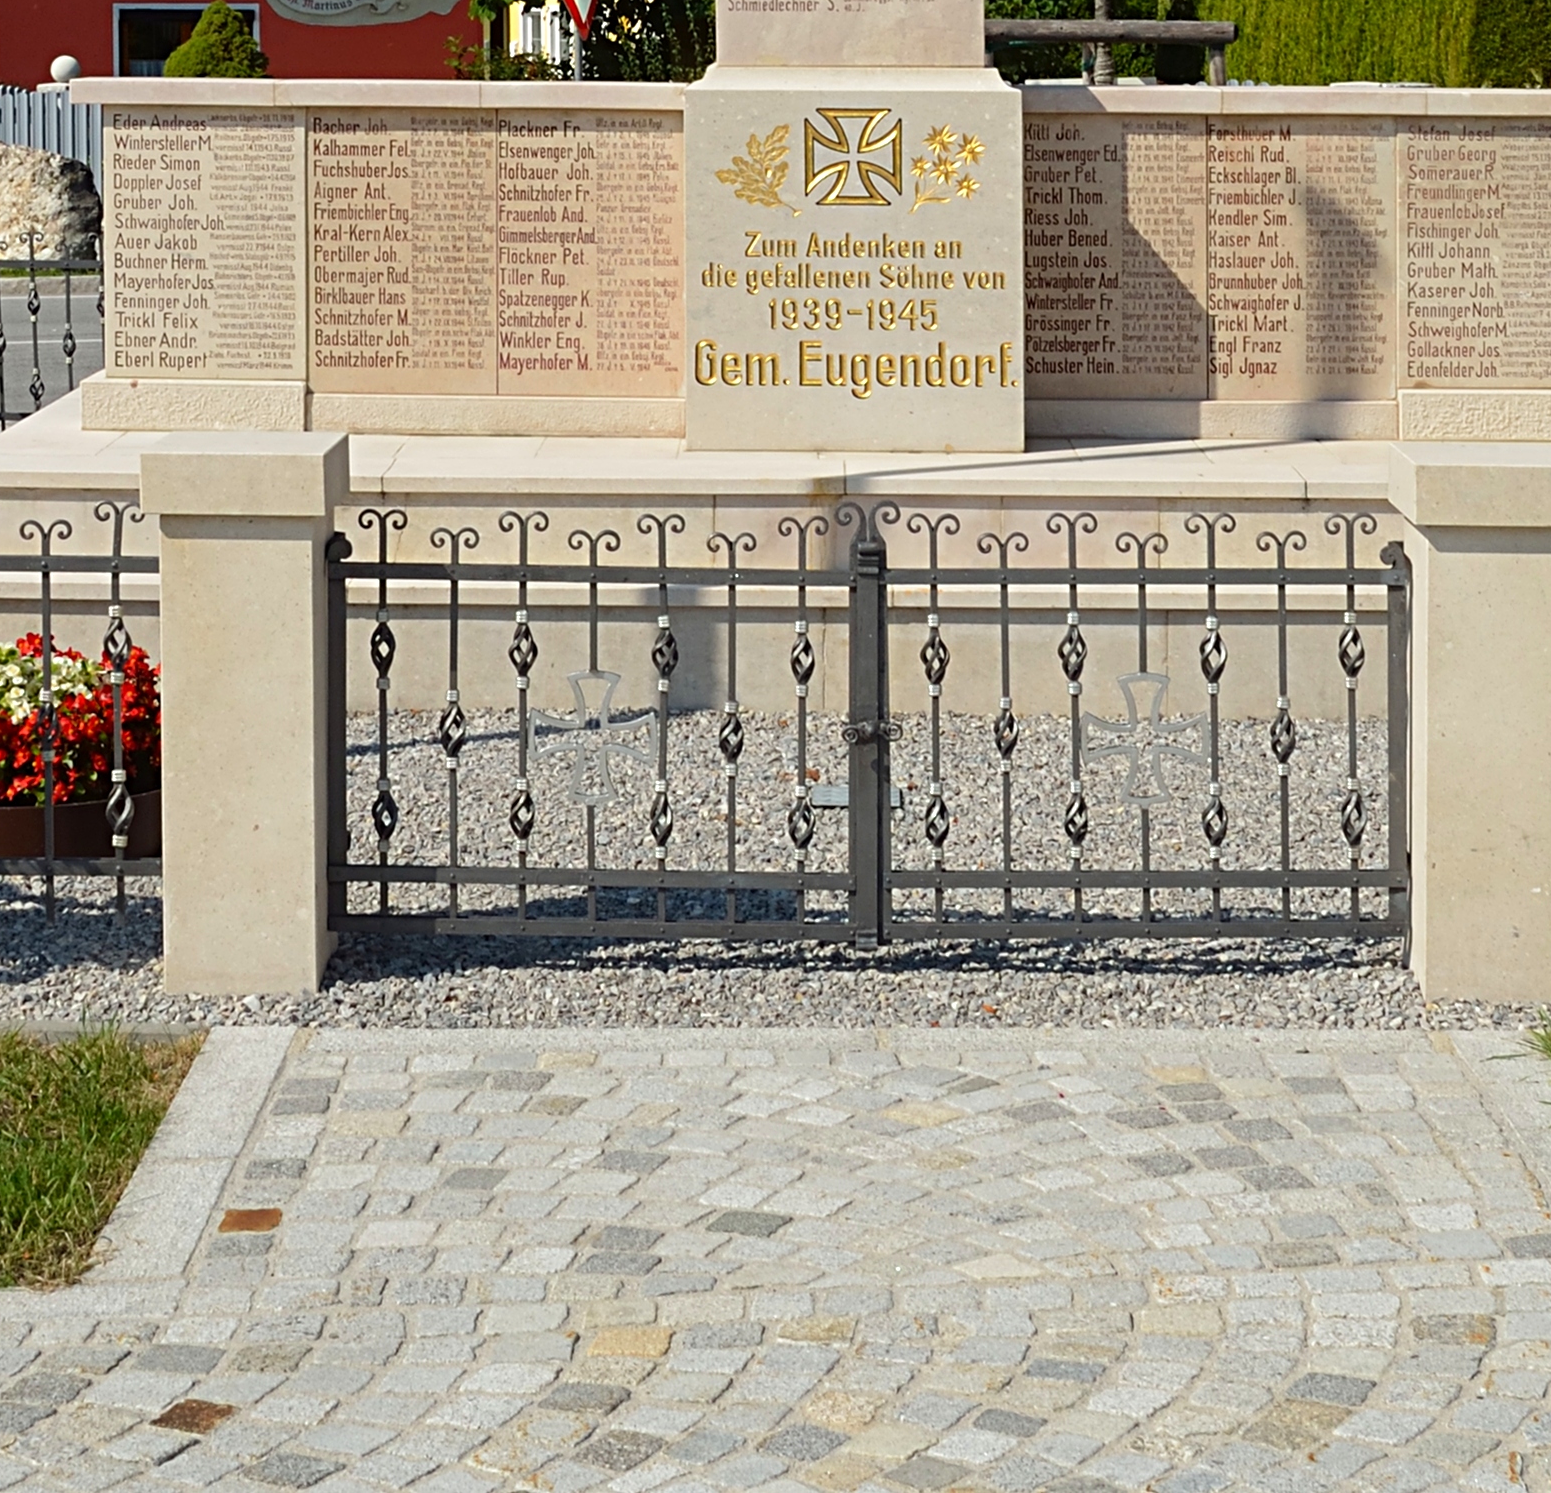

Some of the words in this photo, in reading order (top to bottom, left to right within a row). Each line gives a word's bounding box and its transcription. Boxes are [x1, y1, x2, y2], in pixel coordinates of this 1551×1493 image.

[113, 114, 146, 130] Eder
[150, 115, 206, 131] Andreas
[313, 117, 360, 135] Bacher
[365, 118, 391, 135] Joh.
[499, 120, 558, 137] Plackner
[564, 121, 584, 138] Fr.
[1408, 125, 1450, 141] Stefan
[1459, 126, 1496, 141] Josef
[114, 154, 156, 169] Rieder
[160, 154, 200, 170] Simon
[1261, 146, 1289, 163] Rud.
[1407, 146, 1455, 161] Gruber
[1458, 146, 1496, 164] Georg
[499, 162, 558, 180] Hofbauer
[567, 164, 593, 180] Joh.
[1209, 167, 1281, 187] Eckschlager
[1286, 167, 1301, 184] Bl.
[114, 174, 163, 192] Doppler
[166, 174, 201, 190] Josef
[314, 181, 357, 202] Aigner
[365, 182, 391, 199] Ant.
[114, 193, 161, 209] Gruber
[168, 194, 197, 210] Joh.
[499, 184, 571, 201] Schnitzhofer
[576, 185, 593, 202] Fr.
[1026, 187, 1062, 204] Trickl
[1068, 188, 1108, 205] Thom.
[499, 205, 556, 223] Frauenlob
[562, 207, 587, 223] And.
[1024, 209, 1059, 225] Riess
[1064, 209, 1093, 226] Joh.
[1209, 209, 1258, 226] Kendler
[1264, 210, 1292, 226] Sim.
[115, 233, 151, 249] Auer
[155, 234, 197, 249] Jakob
[744, 231, 797, 258] Zum
[806, 233, 925, 258] Andenken
[935, 239, 963, 258] an
[1024, 230, 1063, 247] Huber
[1069, 230, 1112, 247] Bened.
[1209, 231, 1251, 247] Kaiser
[1258, 231, 1285, 247] Ant.
[314, 245, 370, 262] Pertiller
[374, 246, 401, 262] Joh.
[499, 247, 557, 265] Flöckner
[563, 248, 589, 265] Pet.
[1407, 242, 1433, 258] Kittl
[1439, 243, 1490, 258] Johann
[115, 253, 167, 269] Buchner
[171, 254, 208, 269] Herm.
[1025, 251, 1078, 271] Lugstein
[1084, 252, 1112, 268] Jos.
[1209, 251, 1265, 268] Haslauer
[1271, 252, 1298, 268] Joh.
[315, 266, 384, 287] Obermajer
[500, 268, 534, 285] Tiller
[542, 269, 569, 288] Rup.
[702, 263, 737, 287] die
[746, 263, 870, 294] gefallenen
[879, 264, 954, 289] Söhne
[963, 271, 1005, 289] von
[1408, 262, 1455, 278] Gruber
[1461, 263, 1498, 279] Math.
[315, 287, 375, 305] Birklbauer
[379, 288, 406, 305] Hans
[1407, 282, 1465, 298] Kaserer
[1470, 283, 1497, 298] Joh.
[499, 289, 577, 310] Spatzenegger
[581, 290, 593, 307] K.
[115, 312, 155, 328] Trickl
[163, 312, 198, 328] Felix
[315, 308, 393, 326] Schnitzhofer
[499, 310, 571, 328] Schnitzhofer
[576, 312, 587, 328] J.
[769, 298, 939, 330] 1939-1945
[1211, 315, 1247, 332] Trickl
[1254, 315, 1294, 332] Mart.
[115, 331, 156, 348] Ebner
[159, 333, 198, 348] Andr.
[500, 332, 551, 349] Winkler
[557, 332, 585, 353] Eng.
[1210, 336, 1237, 356] Engl
[1243, 336, 1281, 353] Franz
[115, 351, 153, 367] Eberl
[160, 352, 206, 371] Rupert
[315, 350, 393, 368] Schnitzhofer
[396, 351, 410, 368] Fr.
[499, 353, 573, 375] Mayerhofer
[577, 354, 592, 371] M.
[1026, 357, 1083, 374] Schuster
[1087, 358, 1119, 374] Hein.
[1210, 357, 1232, 378] Sigl
[695, 339, 790, 387] Gem.
[799, 340, 1018, 399] Eugendorf.
